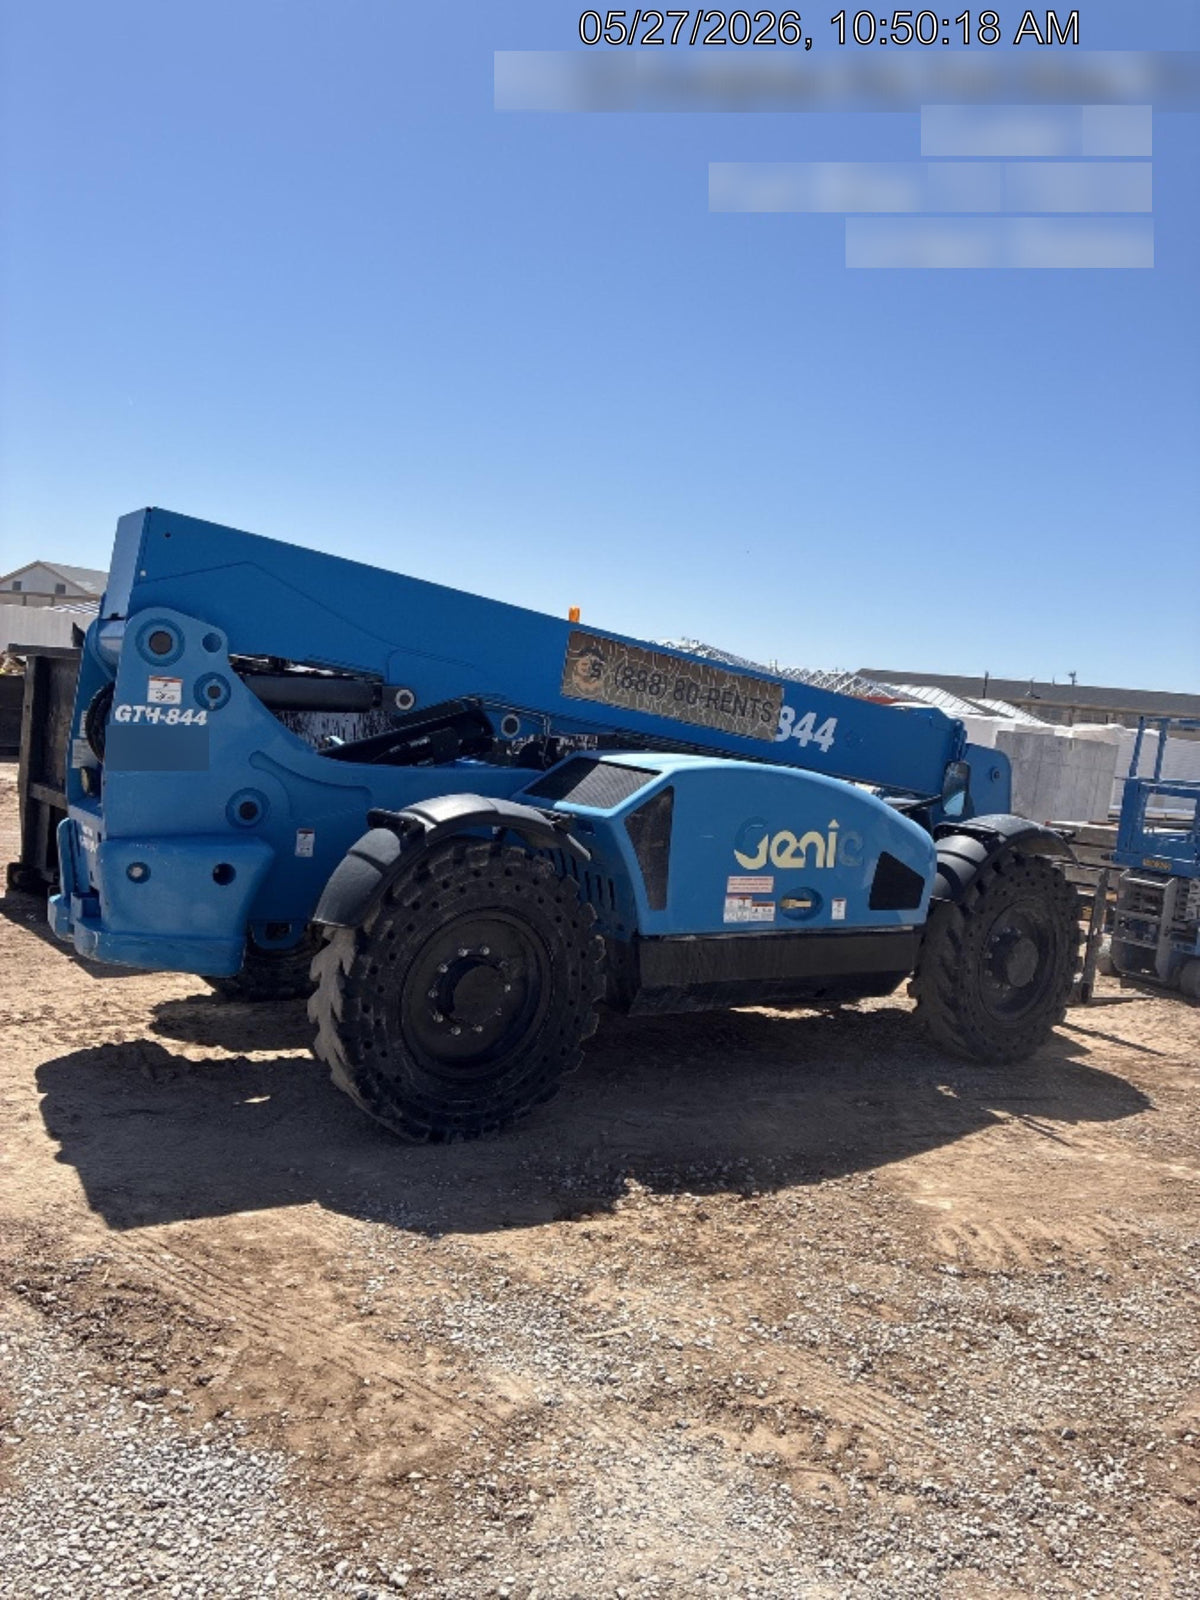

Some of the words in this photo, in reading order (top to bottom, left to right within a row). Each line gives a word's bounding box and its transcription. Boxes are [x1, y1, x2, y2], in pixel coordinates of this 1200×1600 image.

[615, 662, 668, 700] (888)
[673, 679, 775, 723] 80-RENTS
[115, 704, 208, 726] GTH-844
